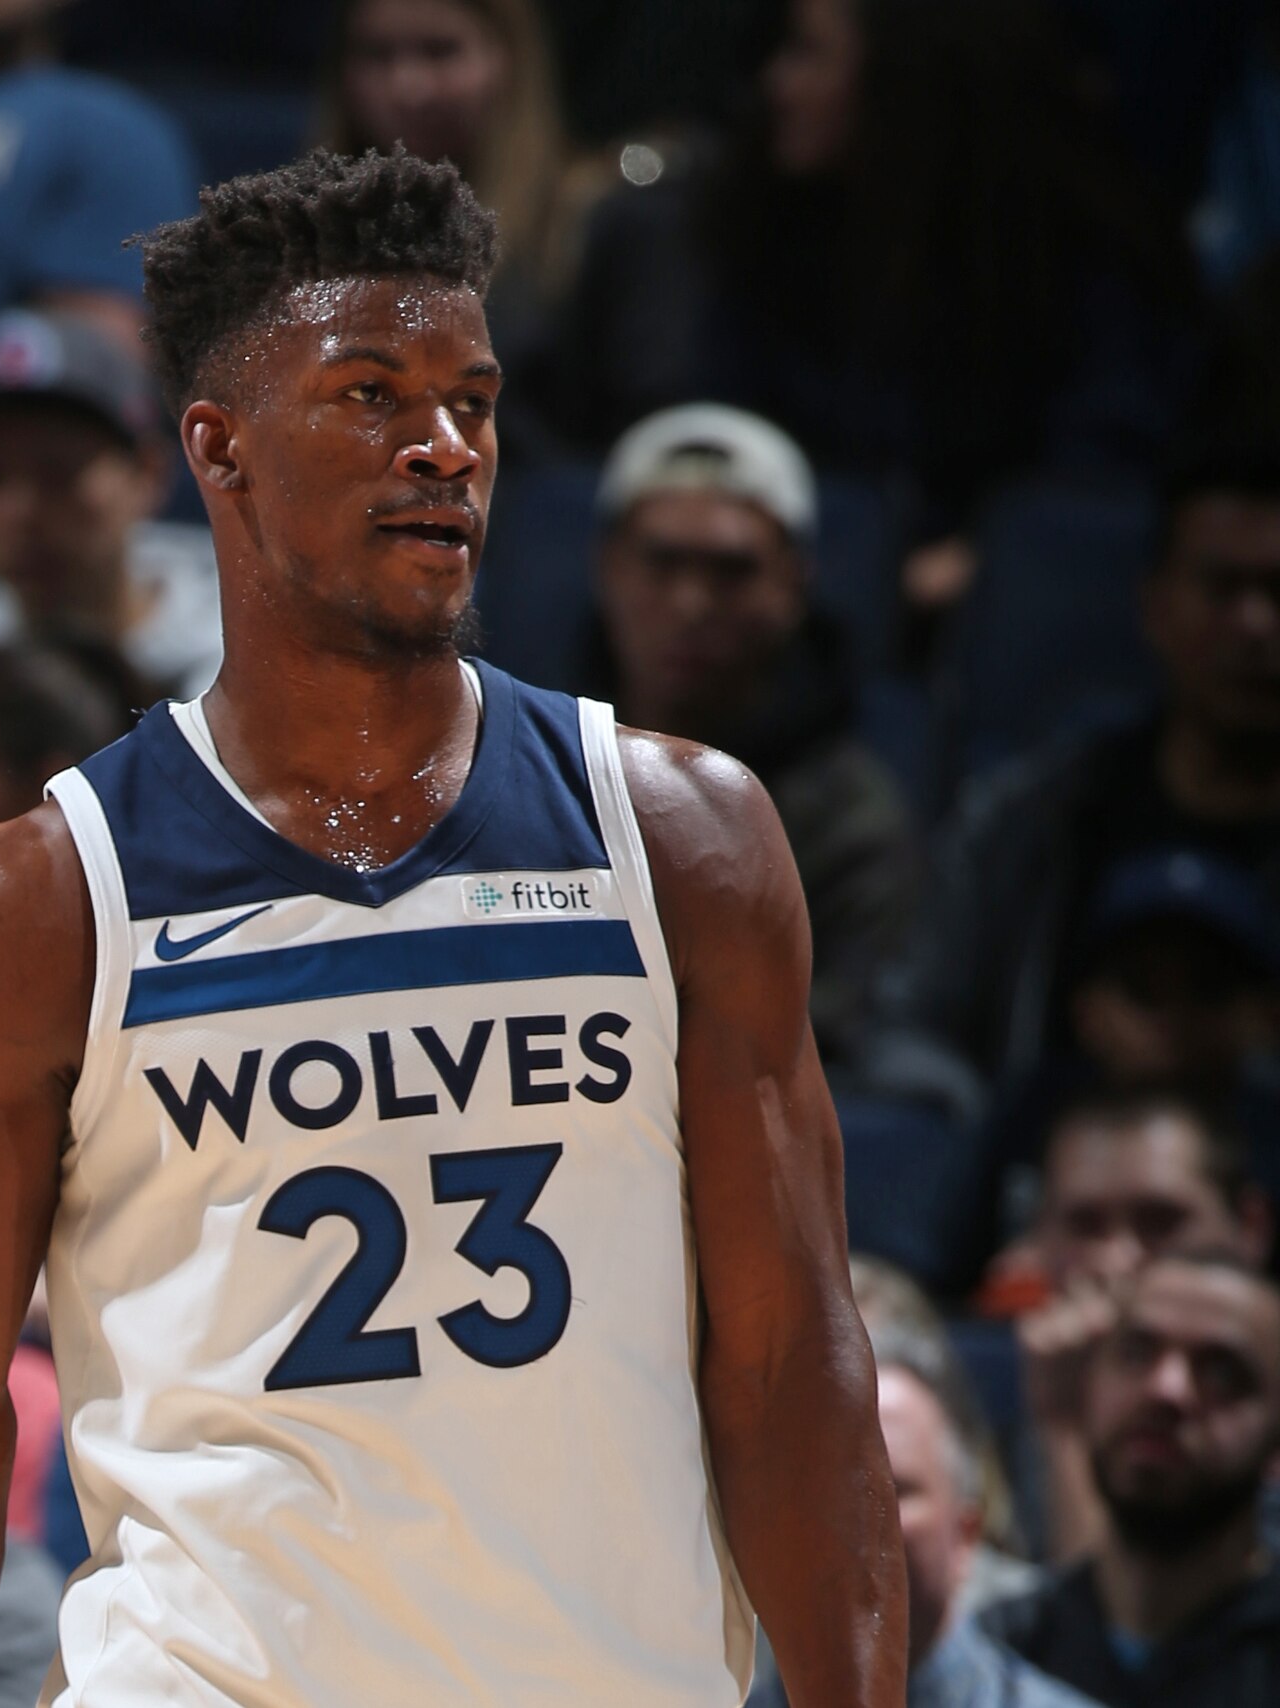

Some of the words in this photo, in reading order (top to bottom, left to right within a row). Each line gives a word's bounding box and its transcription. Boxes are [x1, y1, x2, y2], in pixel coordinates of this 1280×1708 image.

[511, 882, 591, 909] fitbit
[143, 1011, 632, 1152] WOLVES
[257, 1142, 572, 1391] 23
